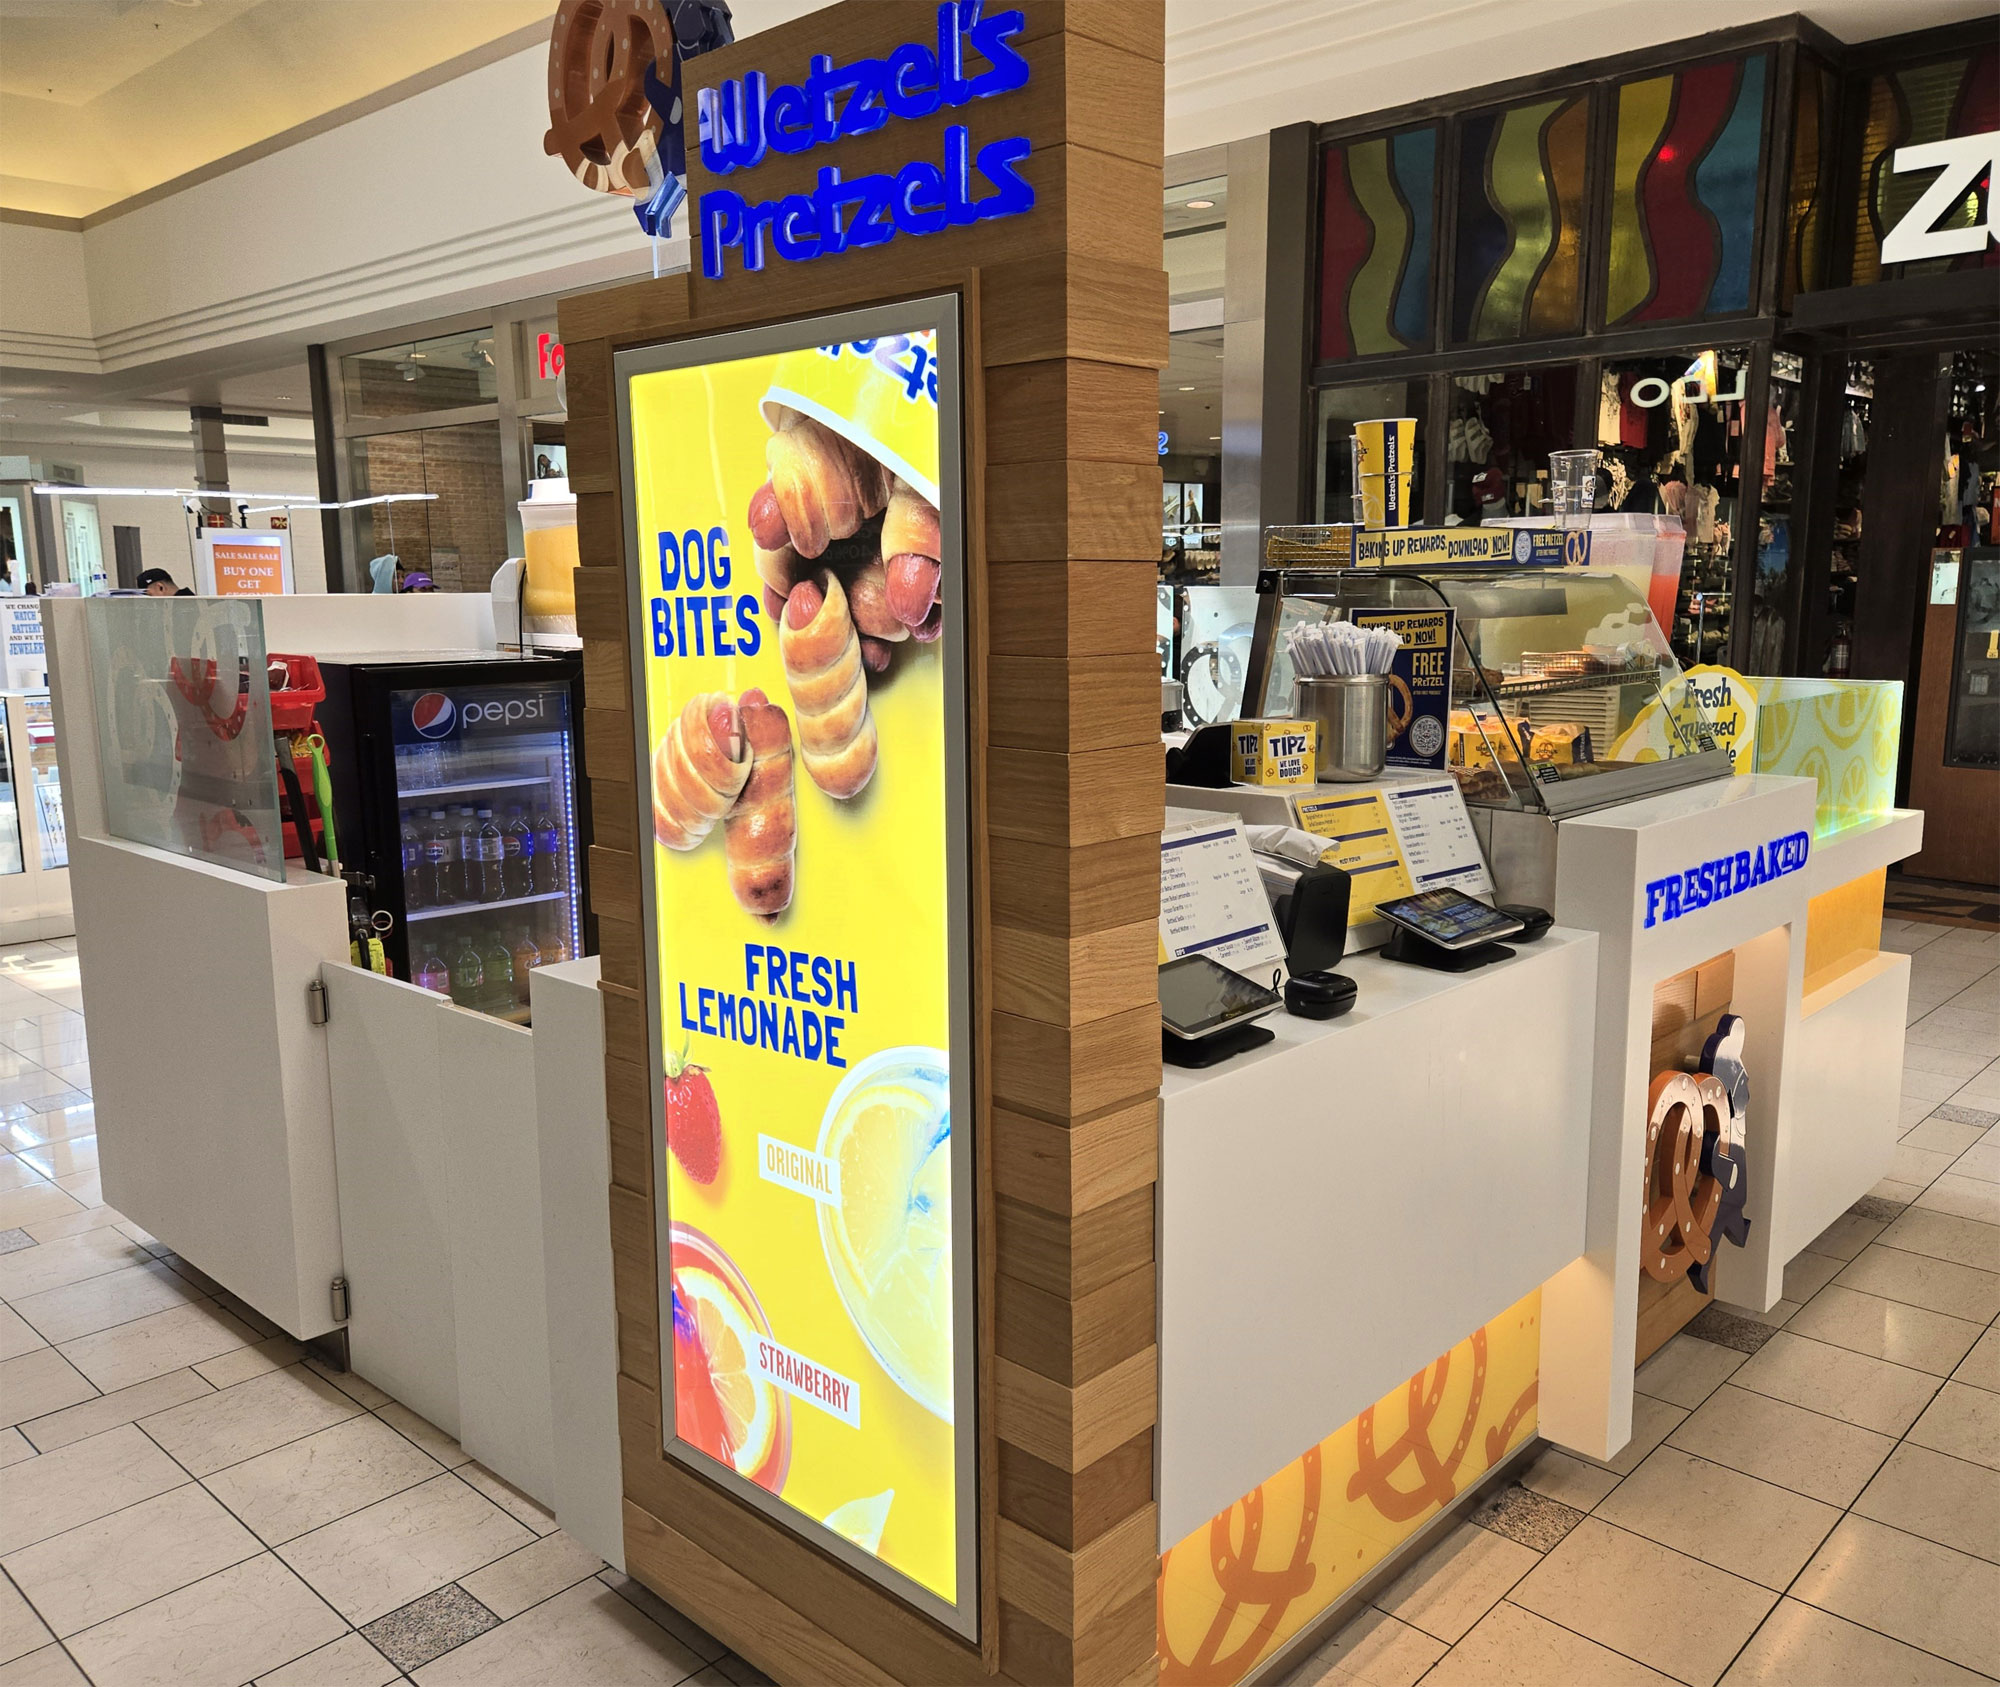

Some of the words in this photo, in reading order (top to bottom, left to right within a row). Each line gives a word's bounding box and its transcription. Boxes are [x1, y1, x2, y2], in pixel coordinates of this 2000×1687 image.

[697, 0, 1030, 176] Wetzel's
[700, 125, 1035, 280] Pretzels
[1881, 131, 2000, 264] Z
[237, 552, 257, 560] SALE
[259, 553, 279, 561] SALE
[658, 526, 731, 592] DOG
[1358, 538, 1390, 560] BAKING
[1393, 538, 1404, 557] UP
[1448, 537, 1488, 559] DOWNLOAD
[1492, 532, 1510, 553] NOW!
[223, 566, 247, 576] BUY
[249, 567, 274, 577] ONE
[237, 579, 261, 589] GET
[13, 611, 36, 620] WATCH
[651, 594, 761, 657] BITES
[1394, 621, 1405, 631] UP
[1407, 616, 1444, 629] REWARDS
[1415, 629, 1436, 644] NOW!
[1412, 652, 1445, 676] FREE
[1412, 677, 1445, 687] PRETZEL
[1683, 677, 1731, 709] Fresh
[463, 693, 544, 729] pepsi
[1238, 734, 1258, 755] TIPZ
[1269, 736, 1306, 757] TIPZ
[1280, 760, 1287, 768] WE
[1288, 758, 1301, 766] LOVE
[1280, 767, 1301, 778] DOUGH
[745, 943, 858, 1013] FRESH
[679, 982, 846, 1068] LEMONADE
[766, 1143, 832, 1195] ORIGINAL
[759, 1341, 850, 1413] STRAWBERRY
